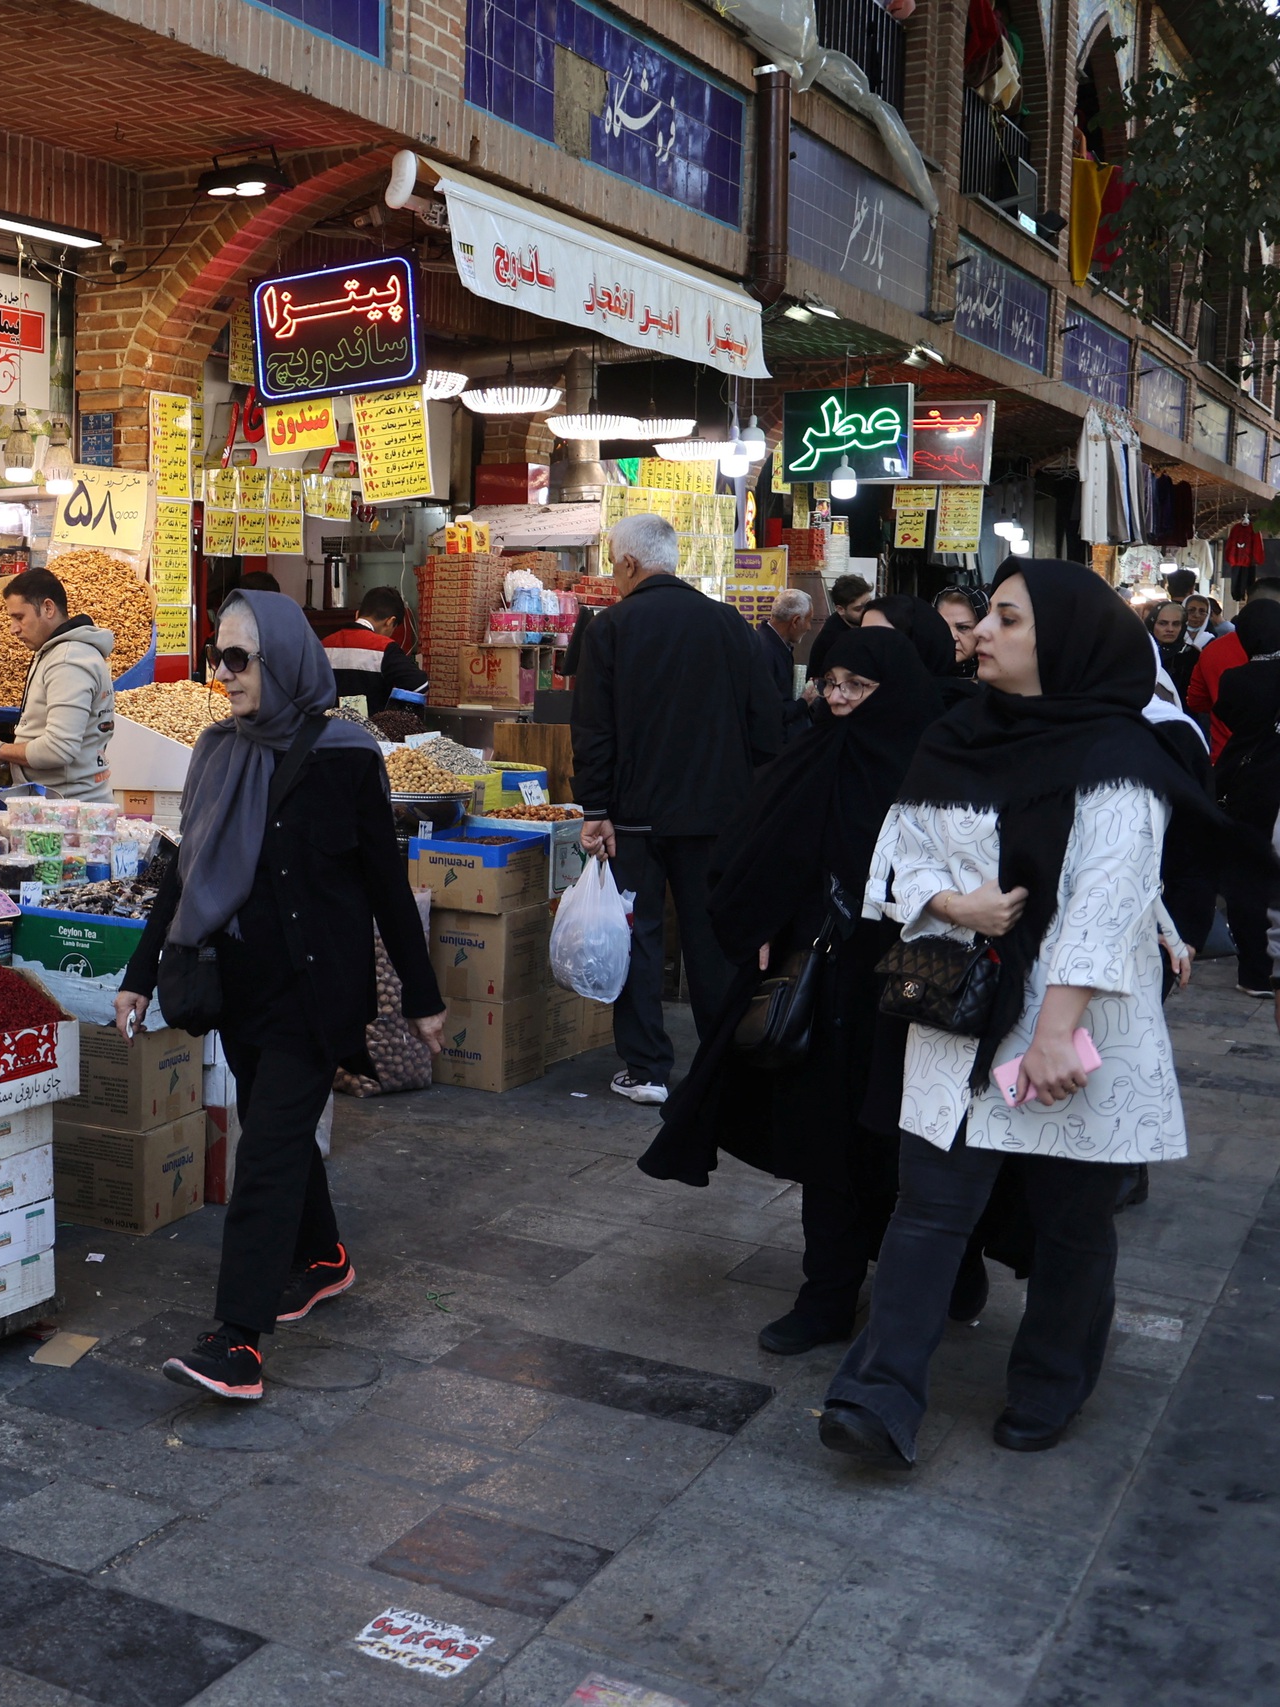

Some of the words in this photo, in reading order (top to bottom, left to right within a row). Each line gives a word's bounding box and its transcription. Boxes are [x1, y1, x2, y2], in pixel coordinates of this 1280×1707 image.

[605, 65, 676, 162] فروشگاه
[839, 186, 869, 272] عطر
[862, 198, 885, 291] بازار
[493, 242, 556, 292] ساندویچ
[263, 275, 404, 339] پیتزا
[639, 306, 680, 339] امیر
[706, 311, 750, 370] پیتزا
[267, 322, 408, 391] ساندویچ
[354, 395, 372, 407] ۱۳۰
[272, 405, 330, 445] صندوق
[358, 425, 376, 436] ۱۳۰
[912, 409, 983, 433] پیت
[789, 396, 901, 471] عطر
[360, 439, 377, 451] ۱۵۰
[362, 466, 378, 478] ۱۹۰
[364, 480, 380, 492] ۱۹۰
[899, 511, 924, 519] فلافل
[900, 533, 919, 545] ۶۰
[428, 856, 475, 869] Premium
[58, 925, 83, 938] Ceylon
[84, 928, 97, 939] Tea
[439, 935, 486, 950] Premium
[158, 1050, 191, 1070] Premium
[161, 1151, 194, 1173] Premium
[116, 1218, 139, 1230] BATCH
[371, 1617, 412, 1637] وام
